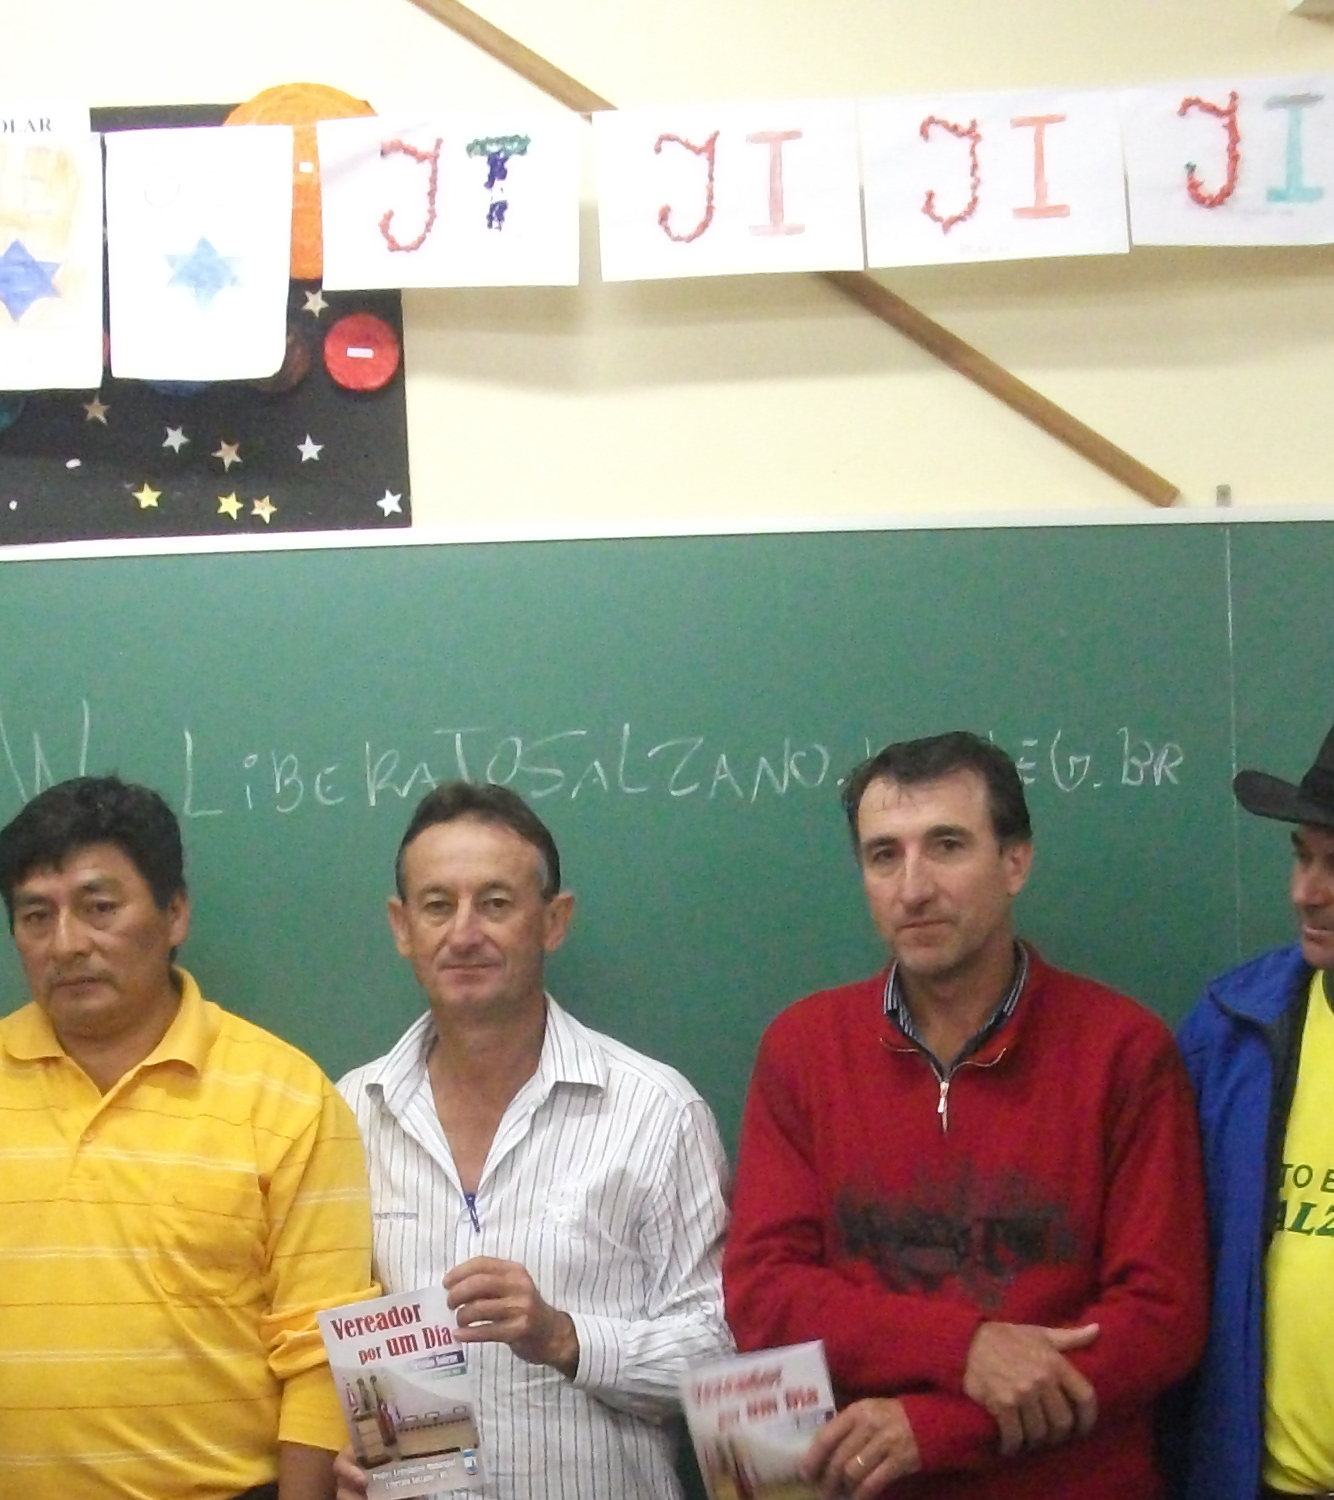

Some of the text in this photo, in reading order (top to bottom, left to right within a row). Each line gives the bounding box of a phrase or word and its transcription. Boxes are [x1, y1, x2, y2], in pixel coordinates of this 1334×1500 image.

[330, 1302, 422, 1342] Vereador
[358, 1344, 382, 1366] por
[385, 1331, 419, 1359] um
[422, 1325, 454, 1351] Dia
